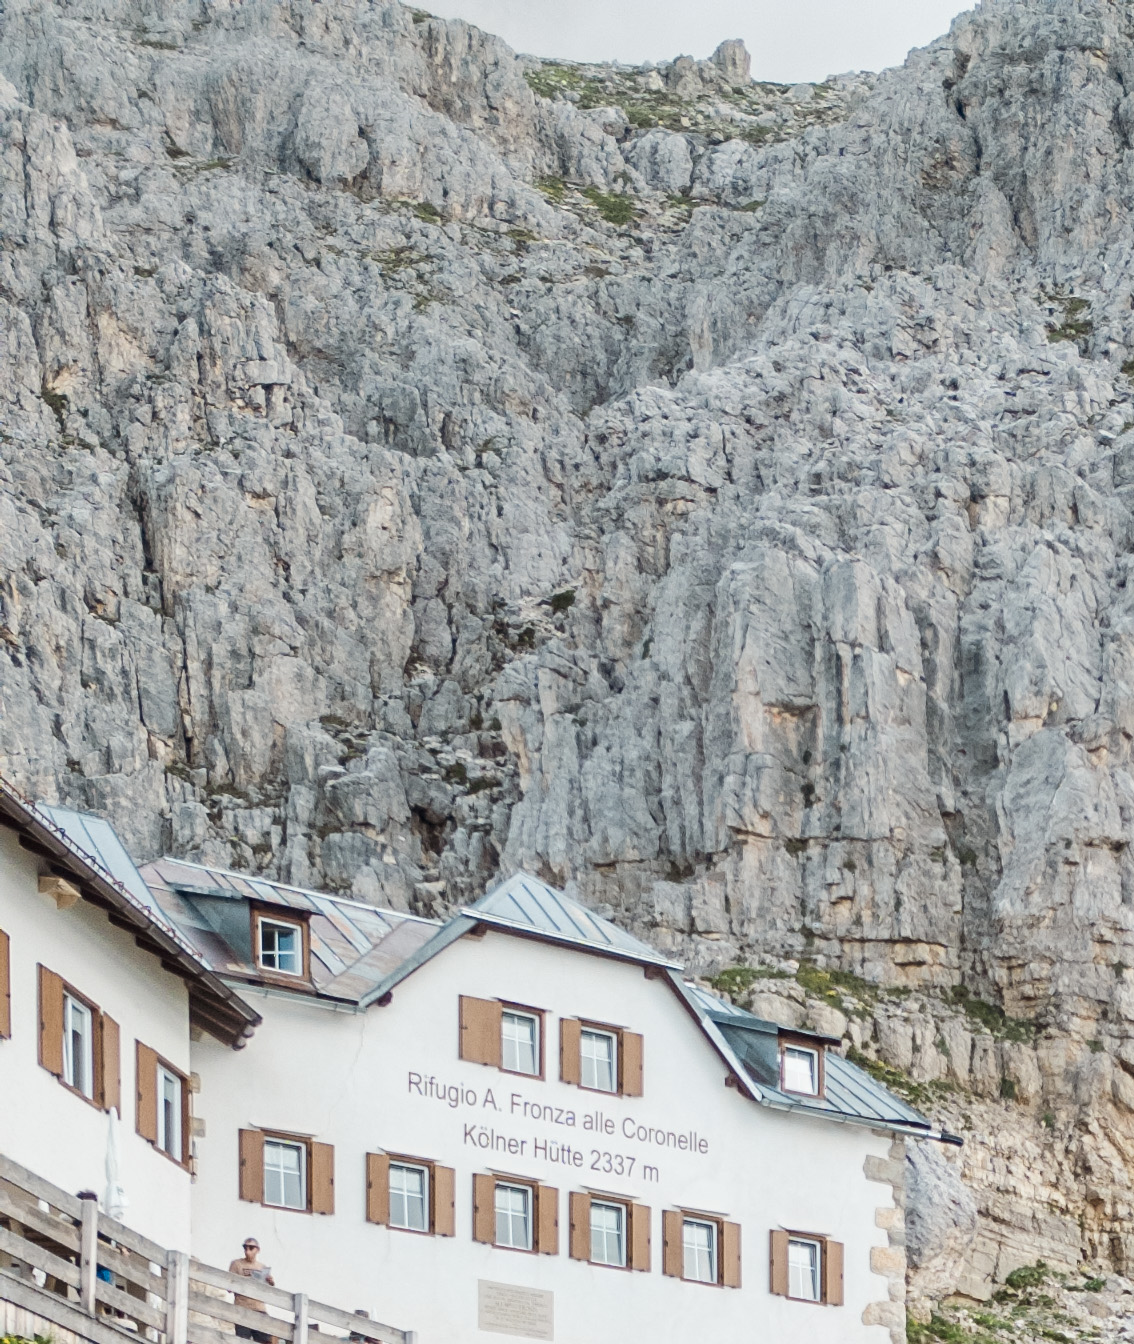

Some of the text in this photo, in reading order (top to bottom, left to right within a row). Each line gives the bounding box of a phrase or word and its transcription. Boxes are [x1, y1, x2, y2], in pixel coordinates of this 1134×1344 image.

[408, 1071, 709, 1154] Rifugio A. Fronza alle Coronelle
[464, 1123, 659, 1182] Kölner Hütte 2337 m
